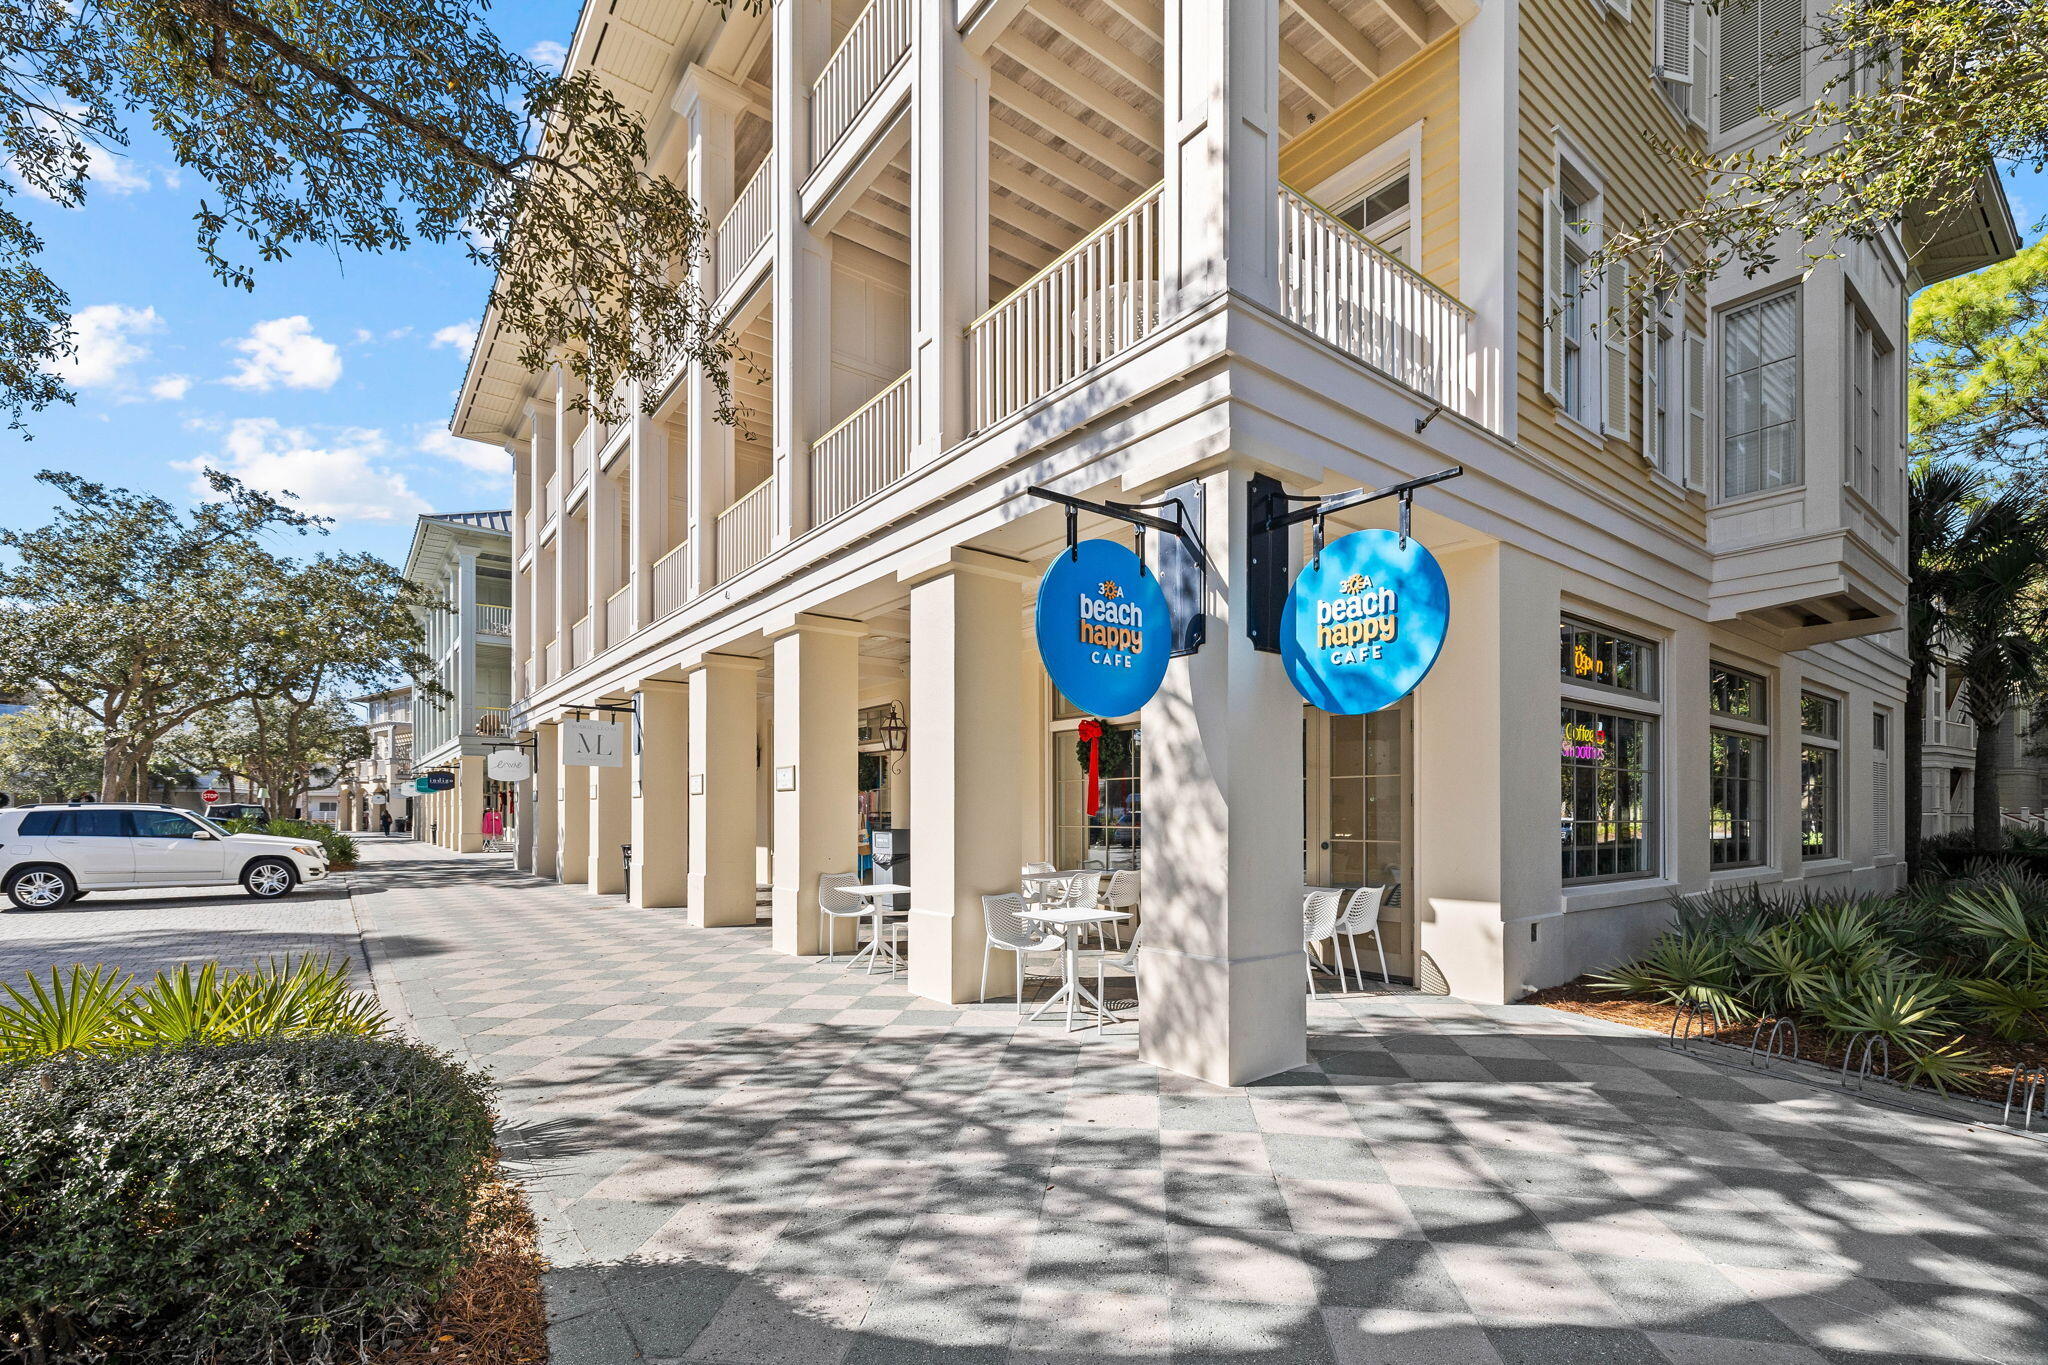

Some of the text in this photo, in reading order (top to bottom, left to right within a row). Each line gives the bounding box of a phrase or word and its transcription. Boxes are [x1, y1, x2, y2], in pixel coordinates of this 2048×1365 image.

[1080, 593, 1142, 627] beach
[1317, 586, 1396, 625] beach
[1080, 619, 1142, 654] happy
[1317, 614, 1397, 649] happy
[1091, 651, 1132, 668] CAFE
[1330, 645, 1383, 665] CAFE
